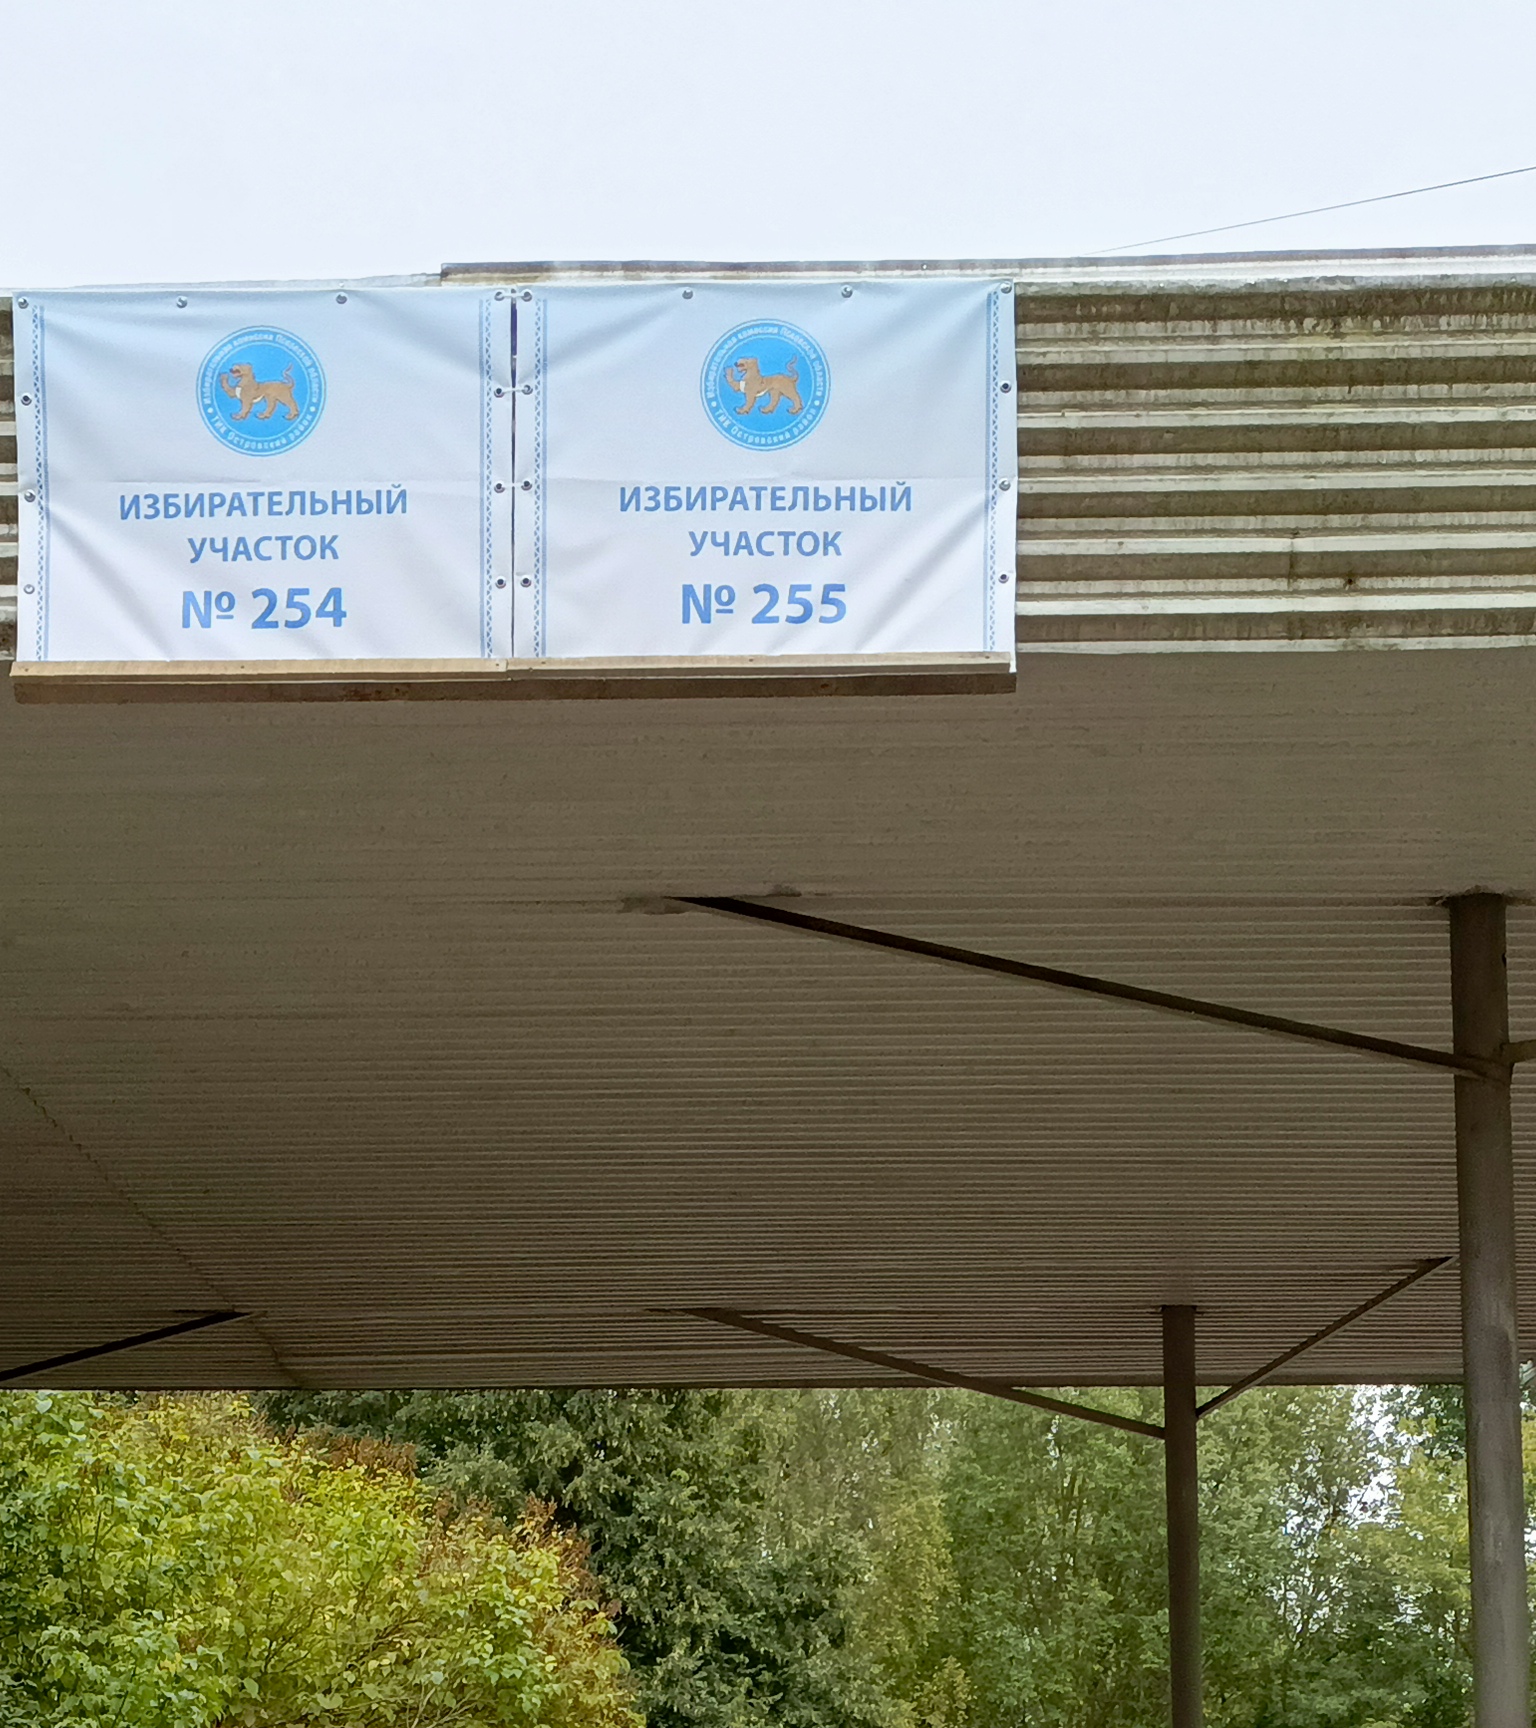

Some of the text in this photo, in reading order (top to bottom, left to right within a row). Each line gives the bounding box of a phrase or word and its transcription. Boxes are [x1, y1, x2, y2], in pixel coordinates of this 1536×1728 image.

[118, 484, 408, 522] ИЗБИРАТЕЛЬНЫЙ
[619, 480, 913, 513] ИЗБИРАТЕЛЬНЫЙ
[188, 534, 339, 564] УЧАСТОК
[689, 530, 843, 558] УЧАСТОК
[182, 587, 348, 630] № 254
[681, 583, 848, 626] № 255
